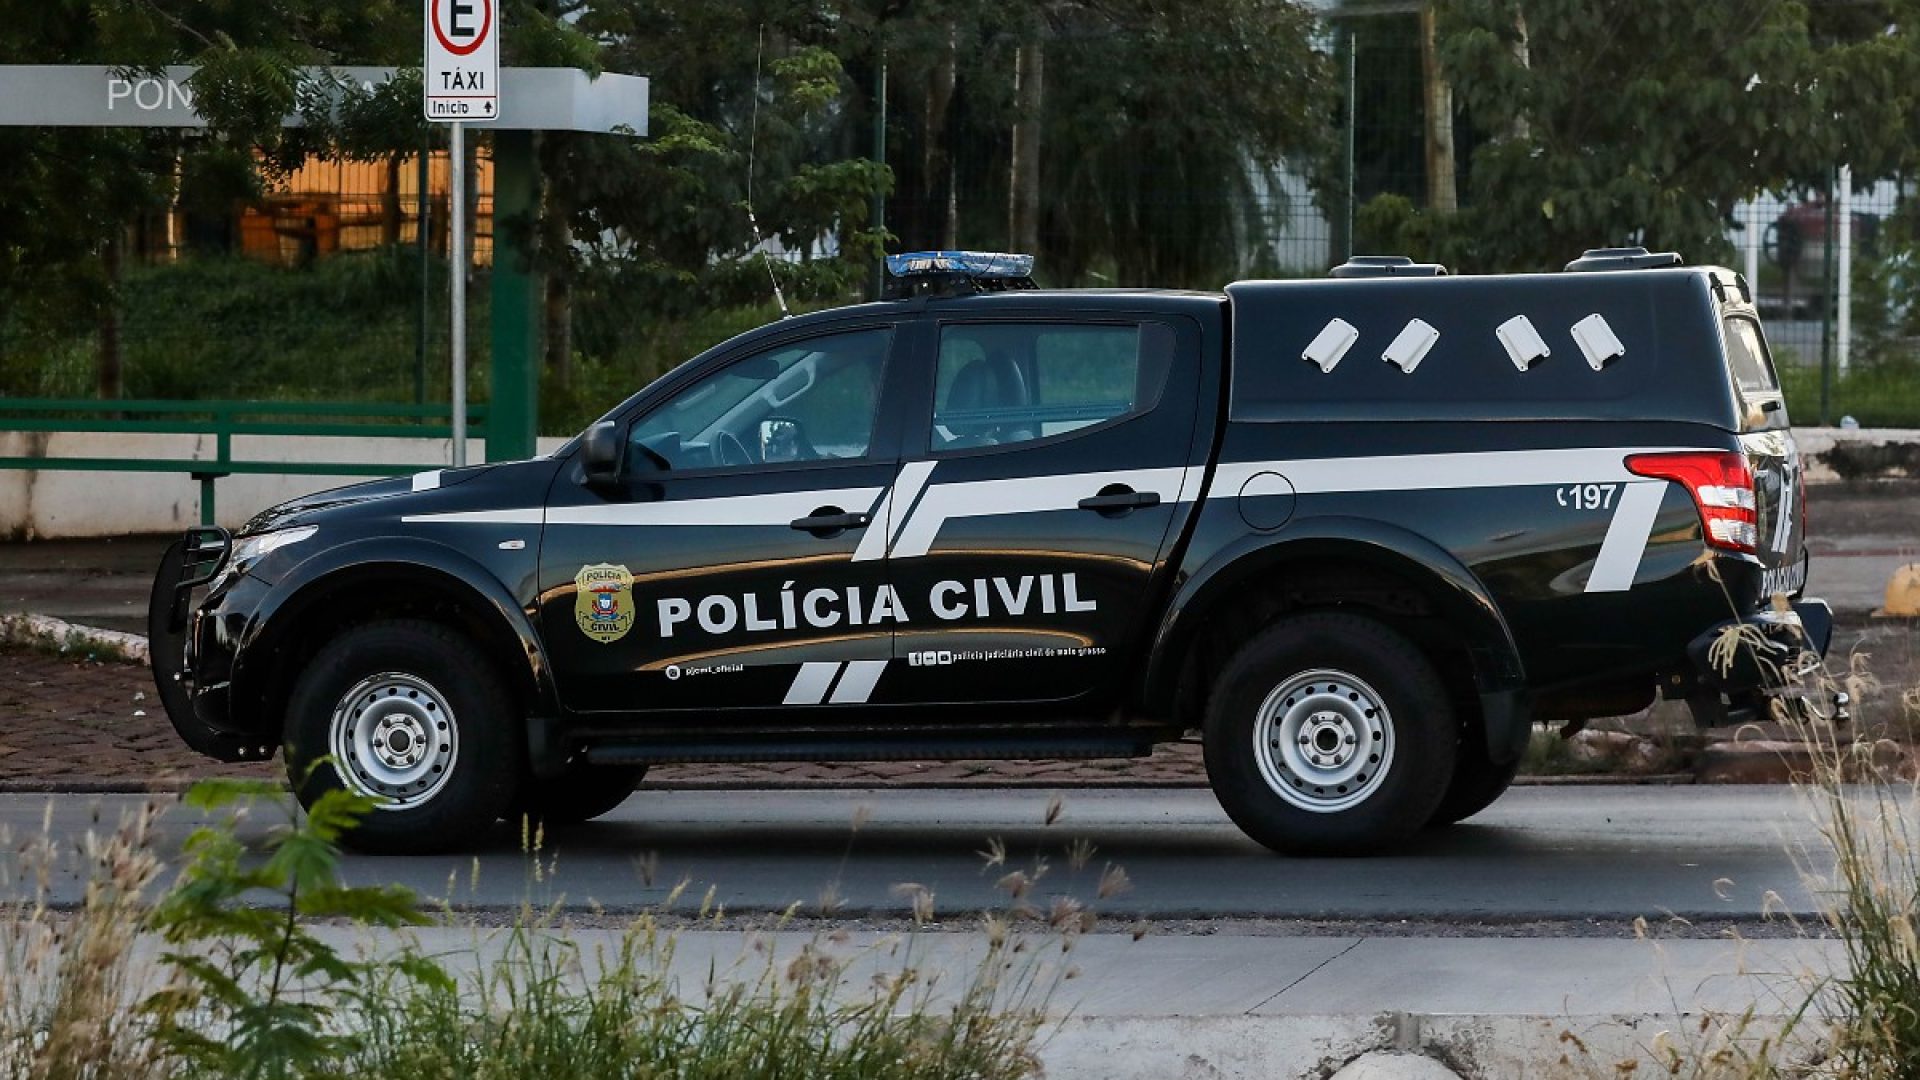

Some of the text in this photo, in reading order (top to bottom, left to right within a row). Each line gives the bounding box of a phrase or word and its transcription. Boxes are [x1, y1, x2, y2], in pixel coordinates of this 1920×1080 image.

[451, 0, 474, 36] E
[441, 67, 484, 90] TÁXI
[107, 79, 193, 110] PON
[1569, 484, 1617, 509] 197
[657, 572, 1097, 638] POLÍCIA CIVIL
[592, 623, 619, 631] CIVIL
